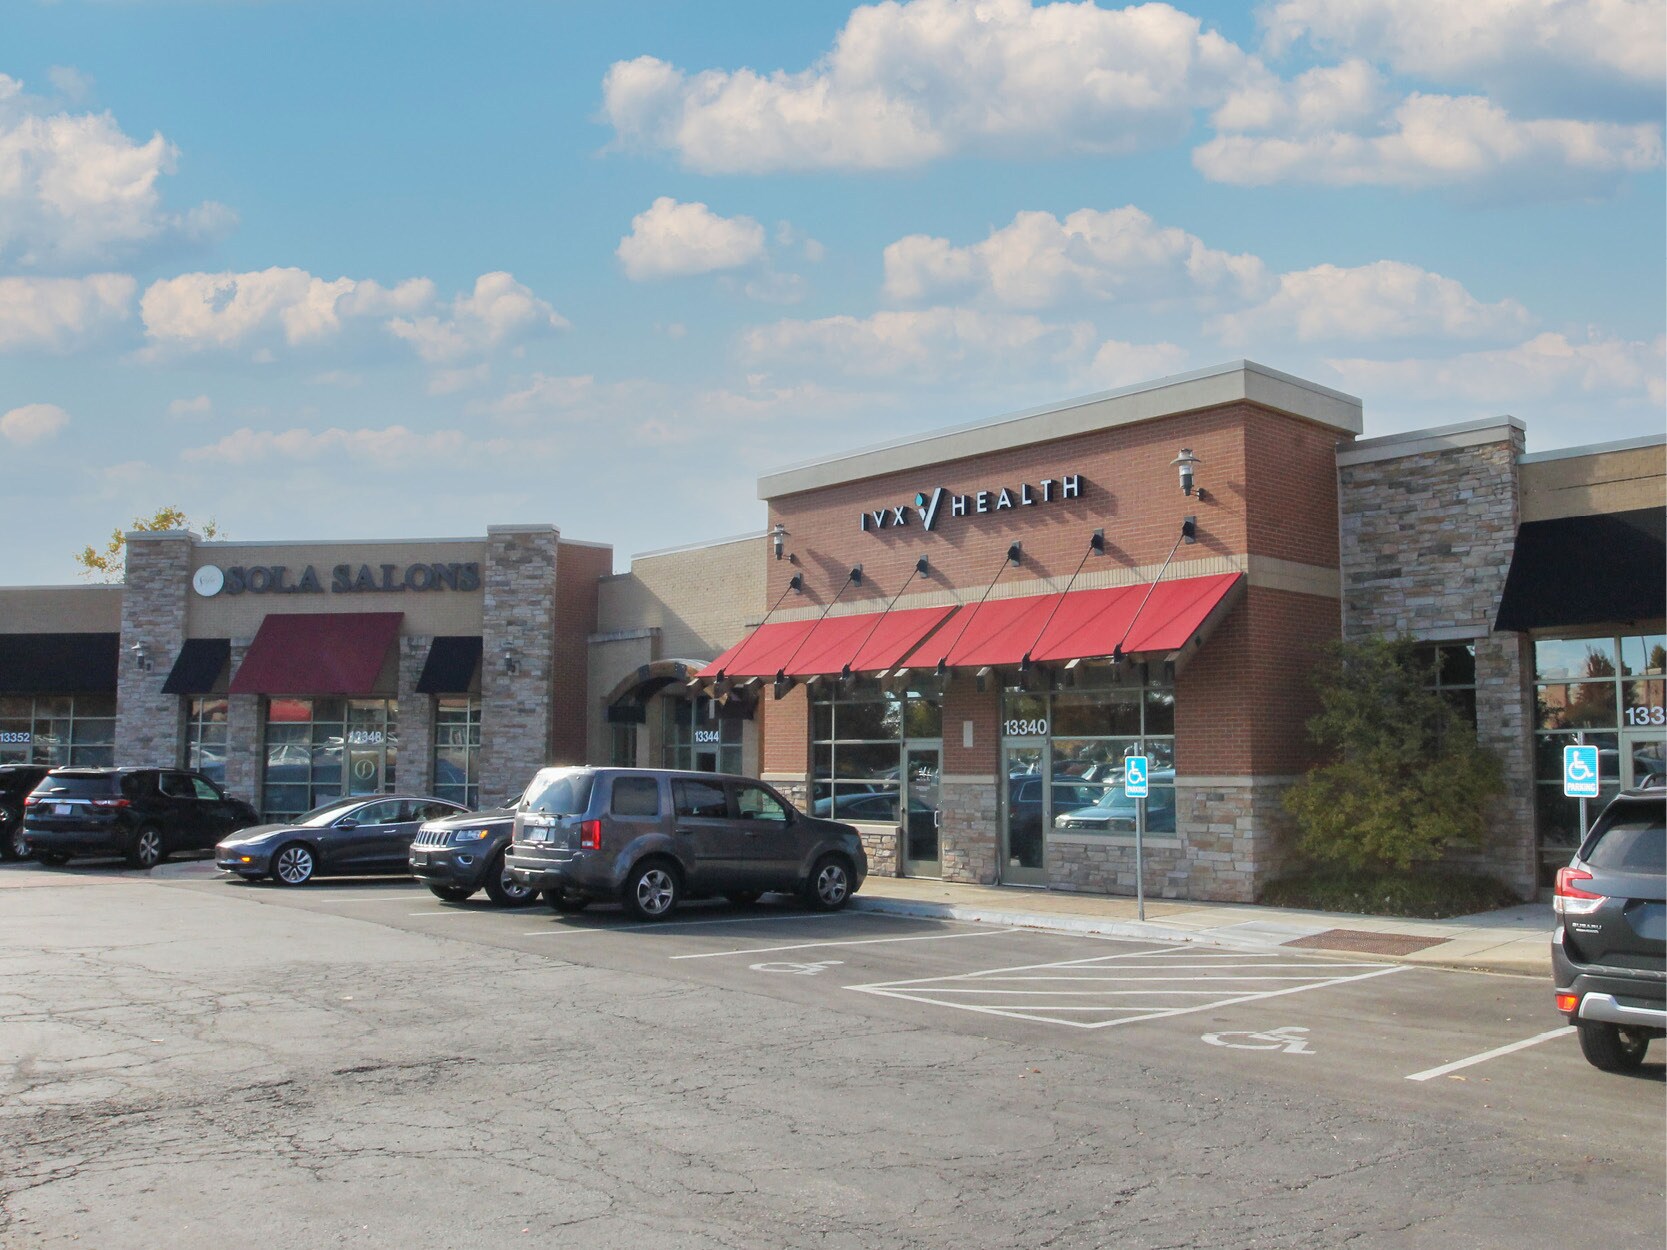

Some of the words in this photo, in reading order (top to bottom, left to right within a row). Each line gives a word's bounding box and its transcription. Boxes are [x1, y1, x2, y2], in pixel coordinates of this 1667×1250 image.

[860, 505, 906, 532] IVX
[951, 474, 1081, 517] HEALTH
[225, 564, 324, 594] SOLA
[331, 562, 481, 593] SALONS
[1003, 718, 1048, 736] 13340
[0, 732, 30, 743] 13352
[347, 730, 382, 744] 13348
[694, 730, 720, 742] 13344
[1127, 785, 1146, 793] PARKING
[1567, 782, 1596, 792] PARKING
